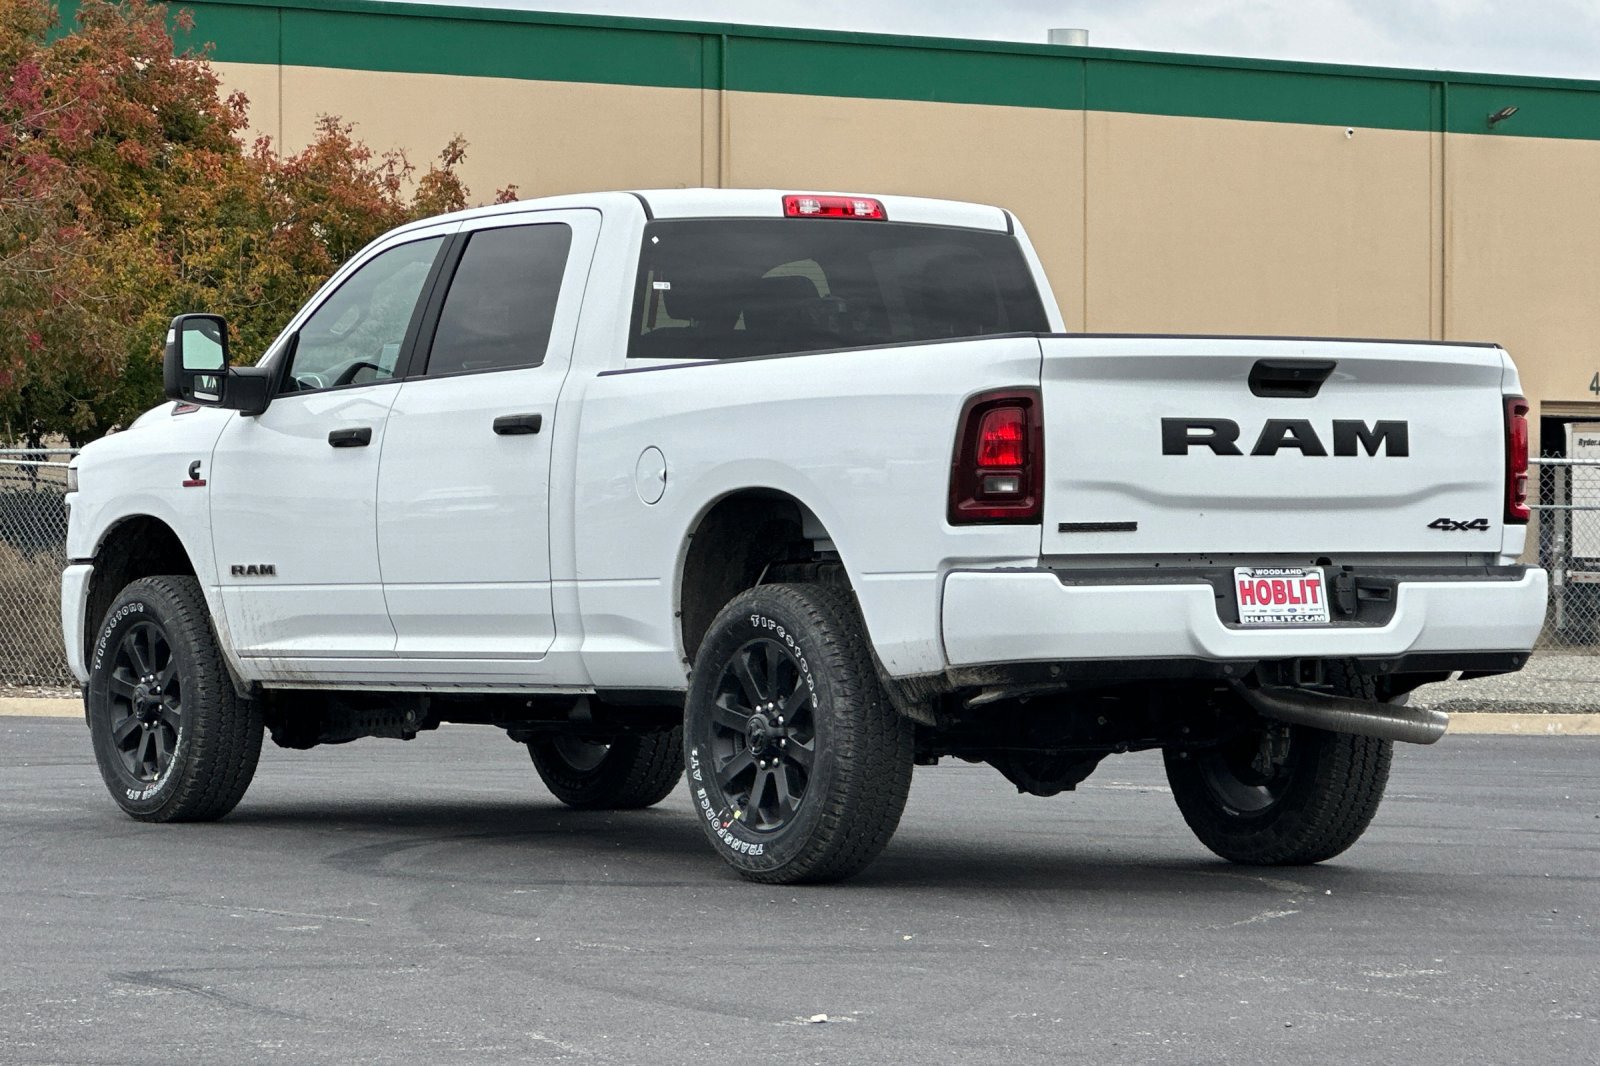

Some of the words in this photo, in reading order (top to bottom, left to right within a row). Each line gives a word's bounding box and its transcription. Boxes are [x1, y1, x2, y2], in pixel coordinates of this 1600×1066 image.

[1161, 417, 1409, 457] RAM
[1427, 518, 1491, 532] 4x4
[231, 564, 276, 575] RAM
[1239, 580, 1320, 605] HOBLIT
[751, 614, 818, 709] Firestone
[697, 787, 764, 856] TRANSFORCE
